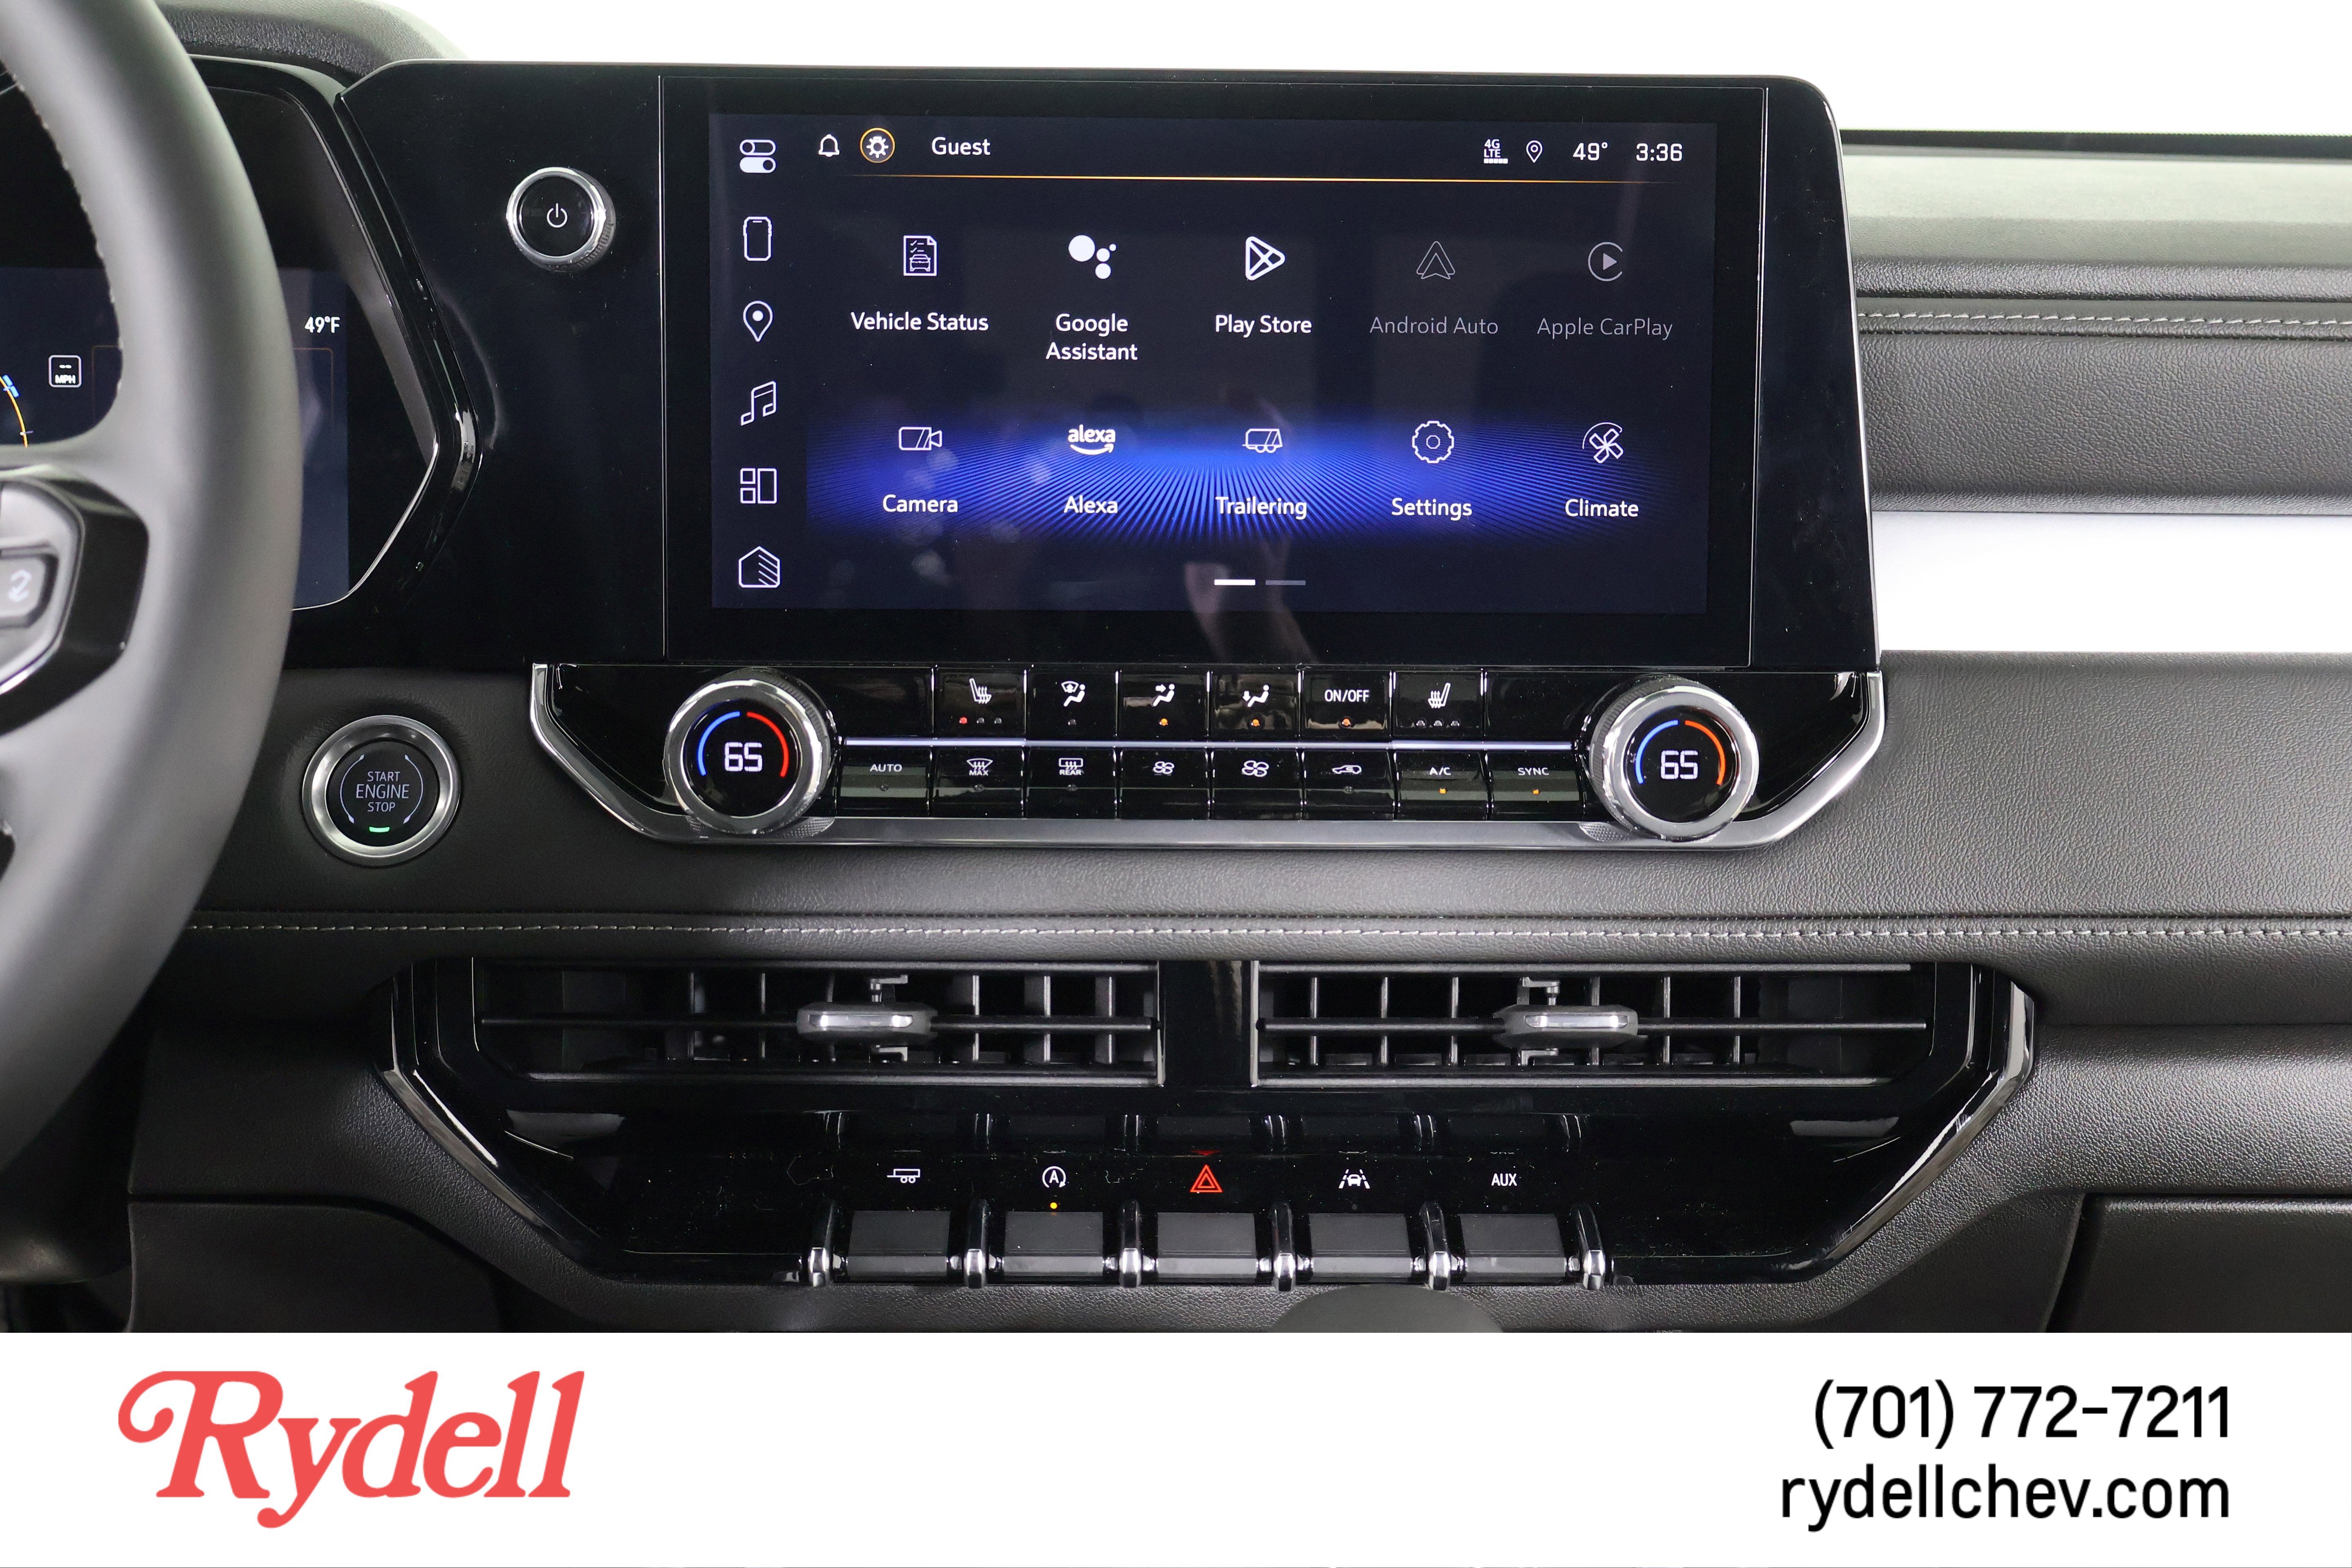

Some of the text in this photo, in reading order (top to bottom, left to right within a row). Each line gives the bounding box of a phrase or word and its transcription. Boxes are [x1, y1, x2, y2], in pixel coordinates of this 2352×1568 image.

[932, 137, 991, 155] Guest
[1484, 139, 1500, 148] 4G
[1572, 142, 1608, 160] 49°
[1636, 143, 1682, 161] 3:36
[1484, 149, 1501, 158] LTE
[304, 316, 340, 333] 49°F
[851, 311, 989, 331] Vehicle Status
[1056, 313, 1128, 337] Google
[1216, 314, 1312, 338] Play Store
[1369, 316, 1498, 334] Android Auto
[1537, 317, 1673, 341] Apple CarPlay
[1045, 342, 1138, 360] Assistant
[55, 374, 76, 384] MPH
[1067, 424, 1116, 443] alexa
[883, 494, 958, 513] Camera
[1063, 494, 1118, 514] Alexa
[1215, 496, 1307, 520] Trailering
[1391, 497, 1472, 521] Settings
[1565, 498, 1639, 517] Climate
[1324, 689, 1370, 702] ON/OFF
[724, 742, 763, 772] 65
[1660, 750, 1698, 780] 65
[367, 771, 400, 782] START
[869, 764, 902, 772] AUTO
[1429, 767, 1451, 776] A/C
[1517, 767, 1549, 776] SYNC
[356, 784, 410, 799] ENGINE
[367, 802, 395, 812] STOP
[1491, 1173, 1517, 1186] AUX
